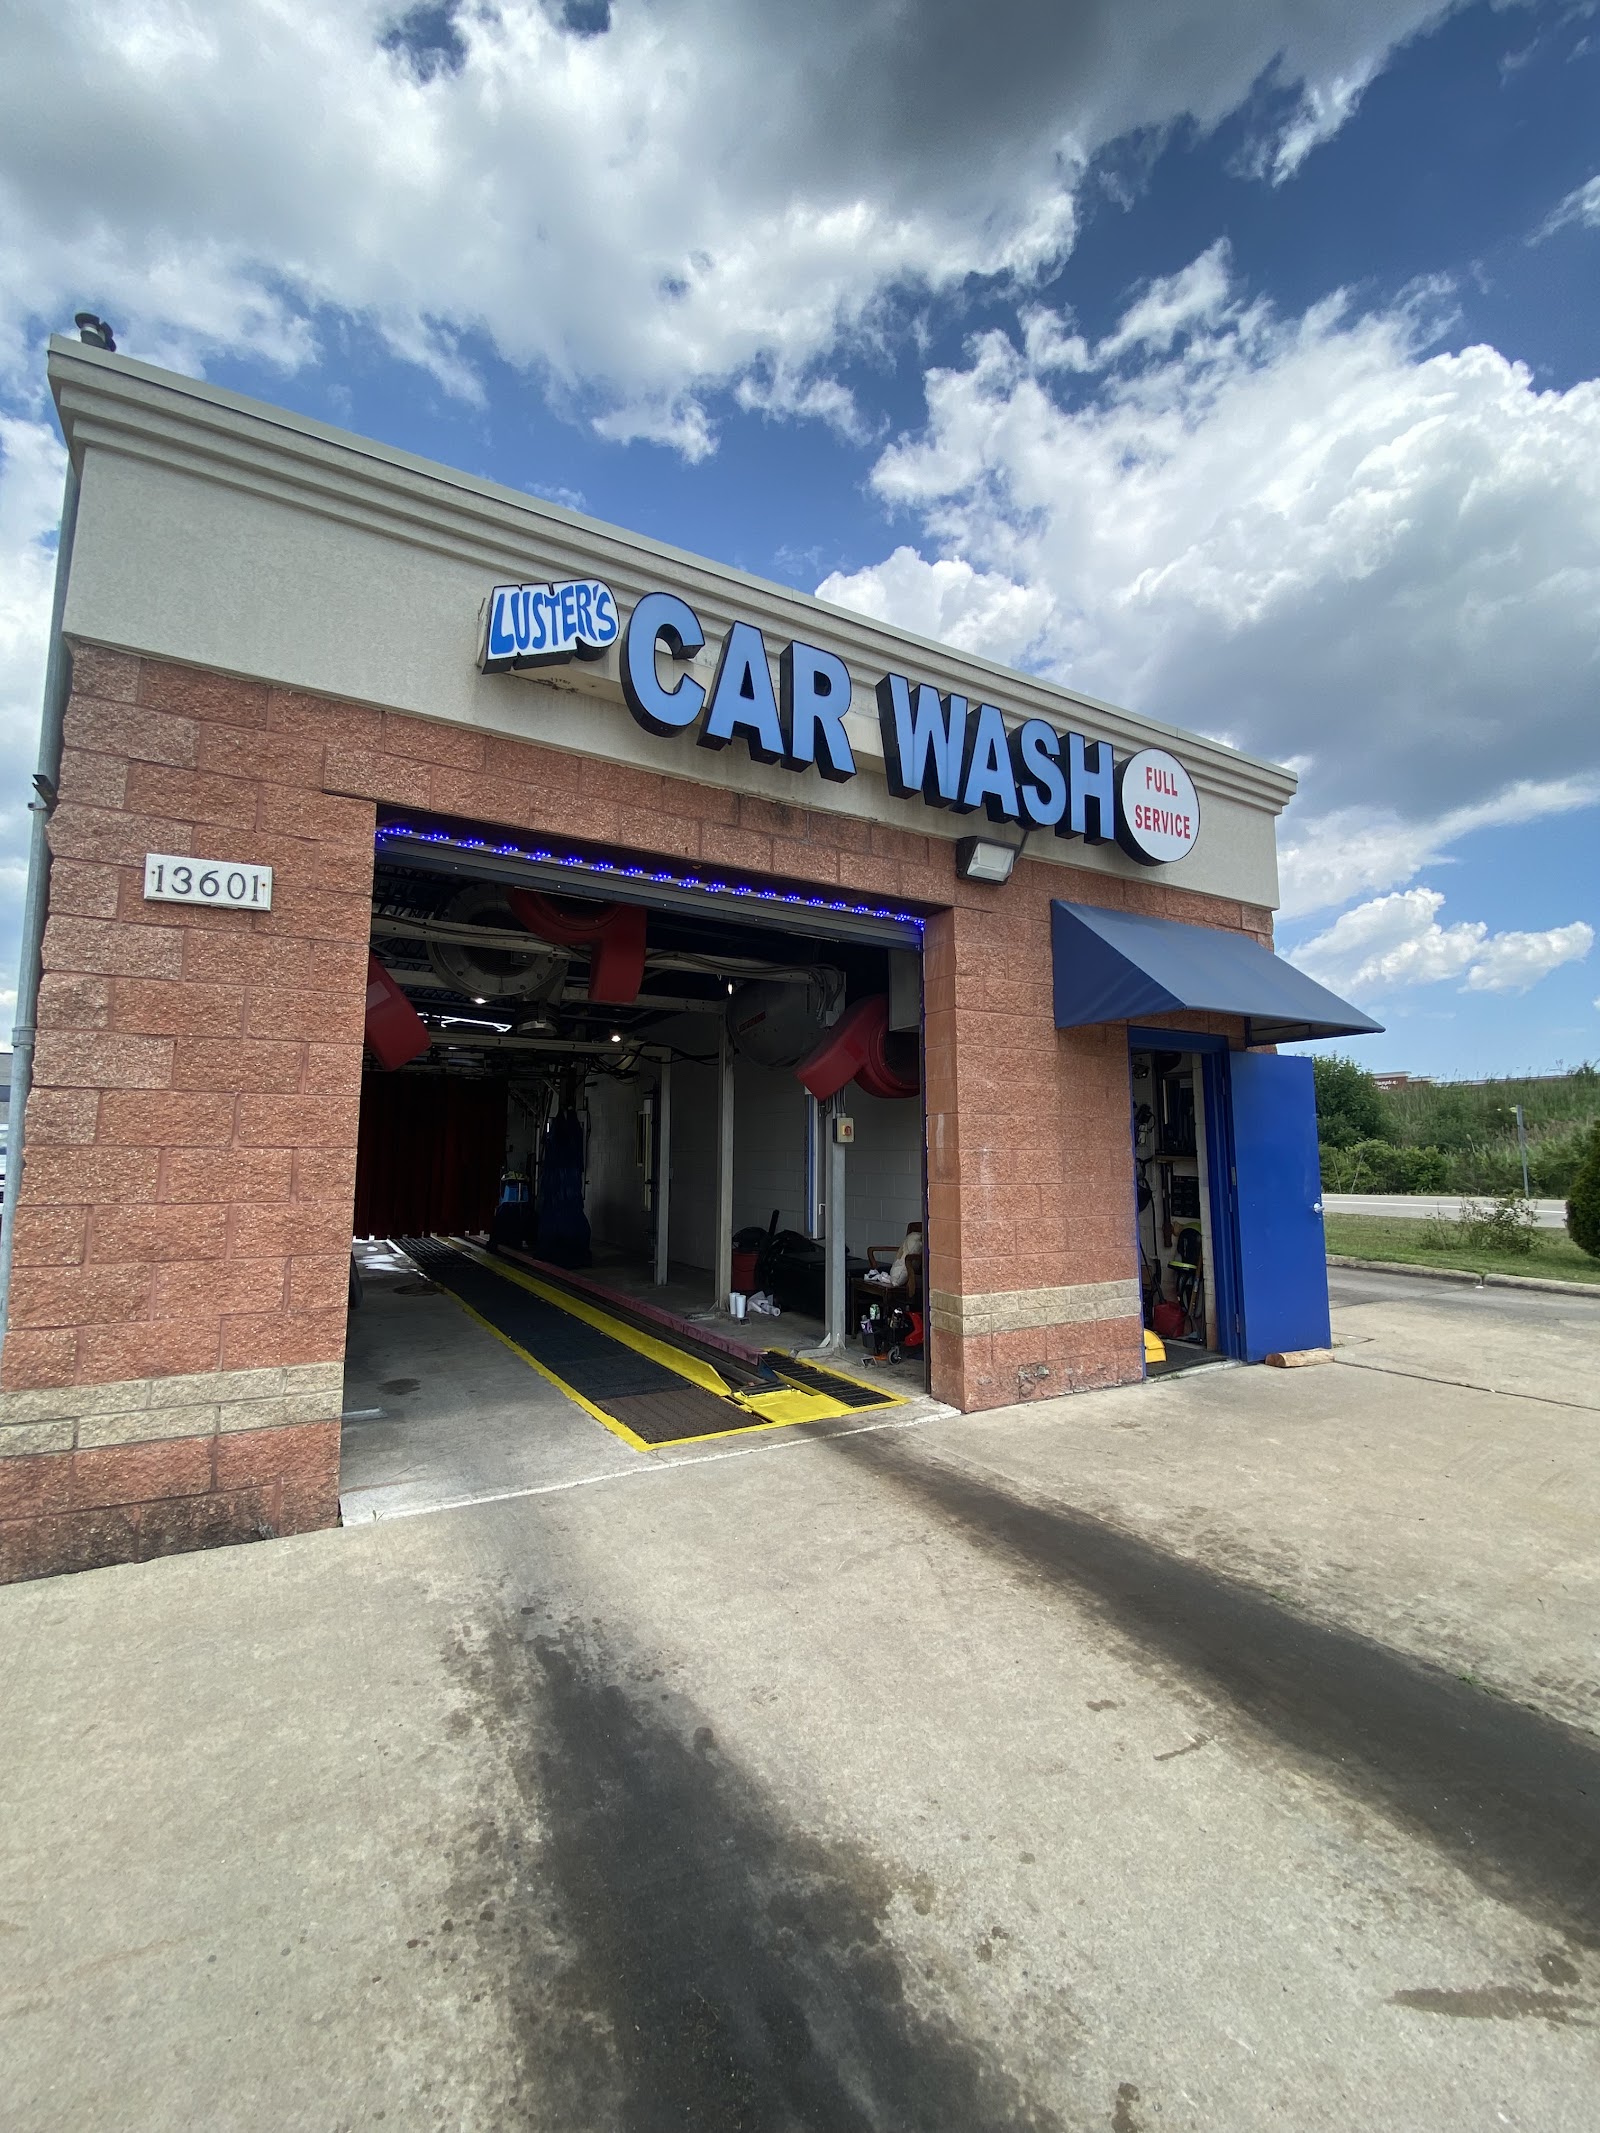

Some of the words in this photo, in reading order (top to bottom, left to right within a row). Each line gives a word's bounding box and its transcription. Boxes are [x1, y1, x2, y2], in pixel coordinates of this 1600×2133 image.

[490, 583, 617, 655] LUSTER'S
[627, 592, 857, 775] CAR
[888, 672, 1115, 840] WASH
[1145, 766, 1178, 797] FULL
[1134, 804, 1191, 840] SERVICE
[155, 864, 259, 902] 13601
